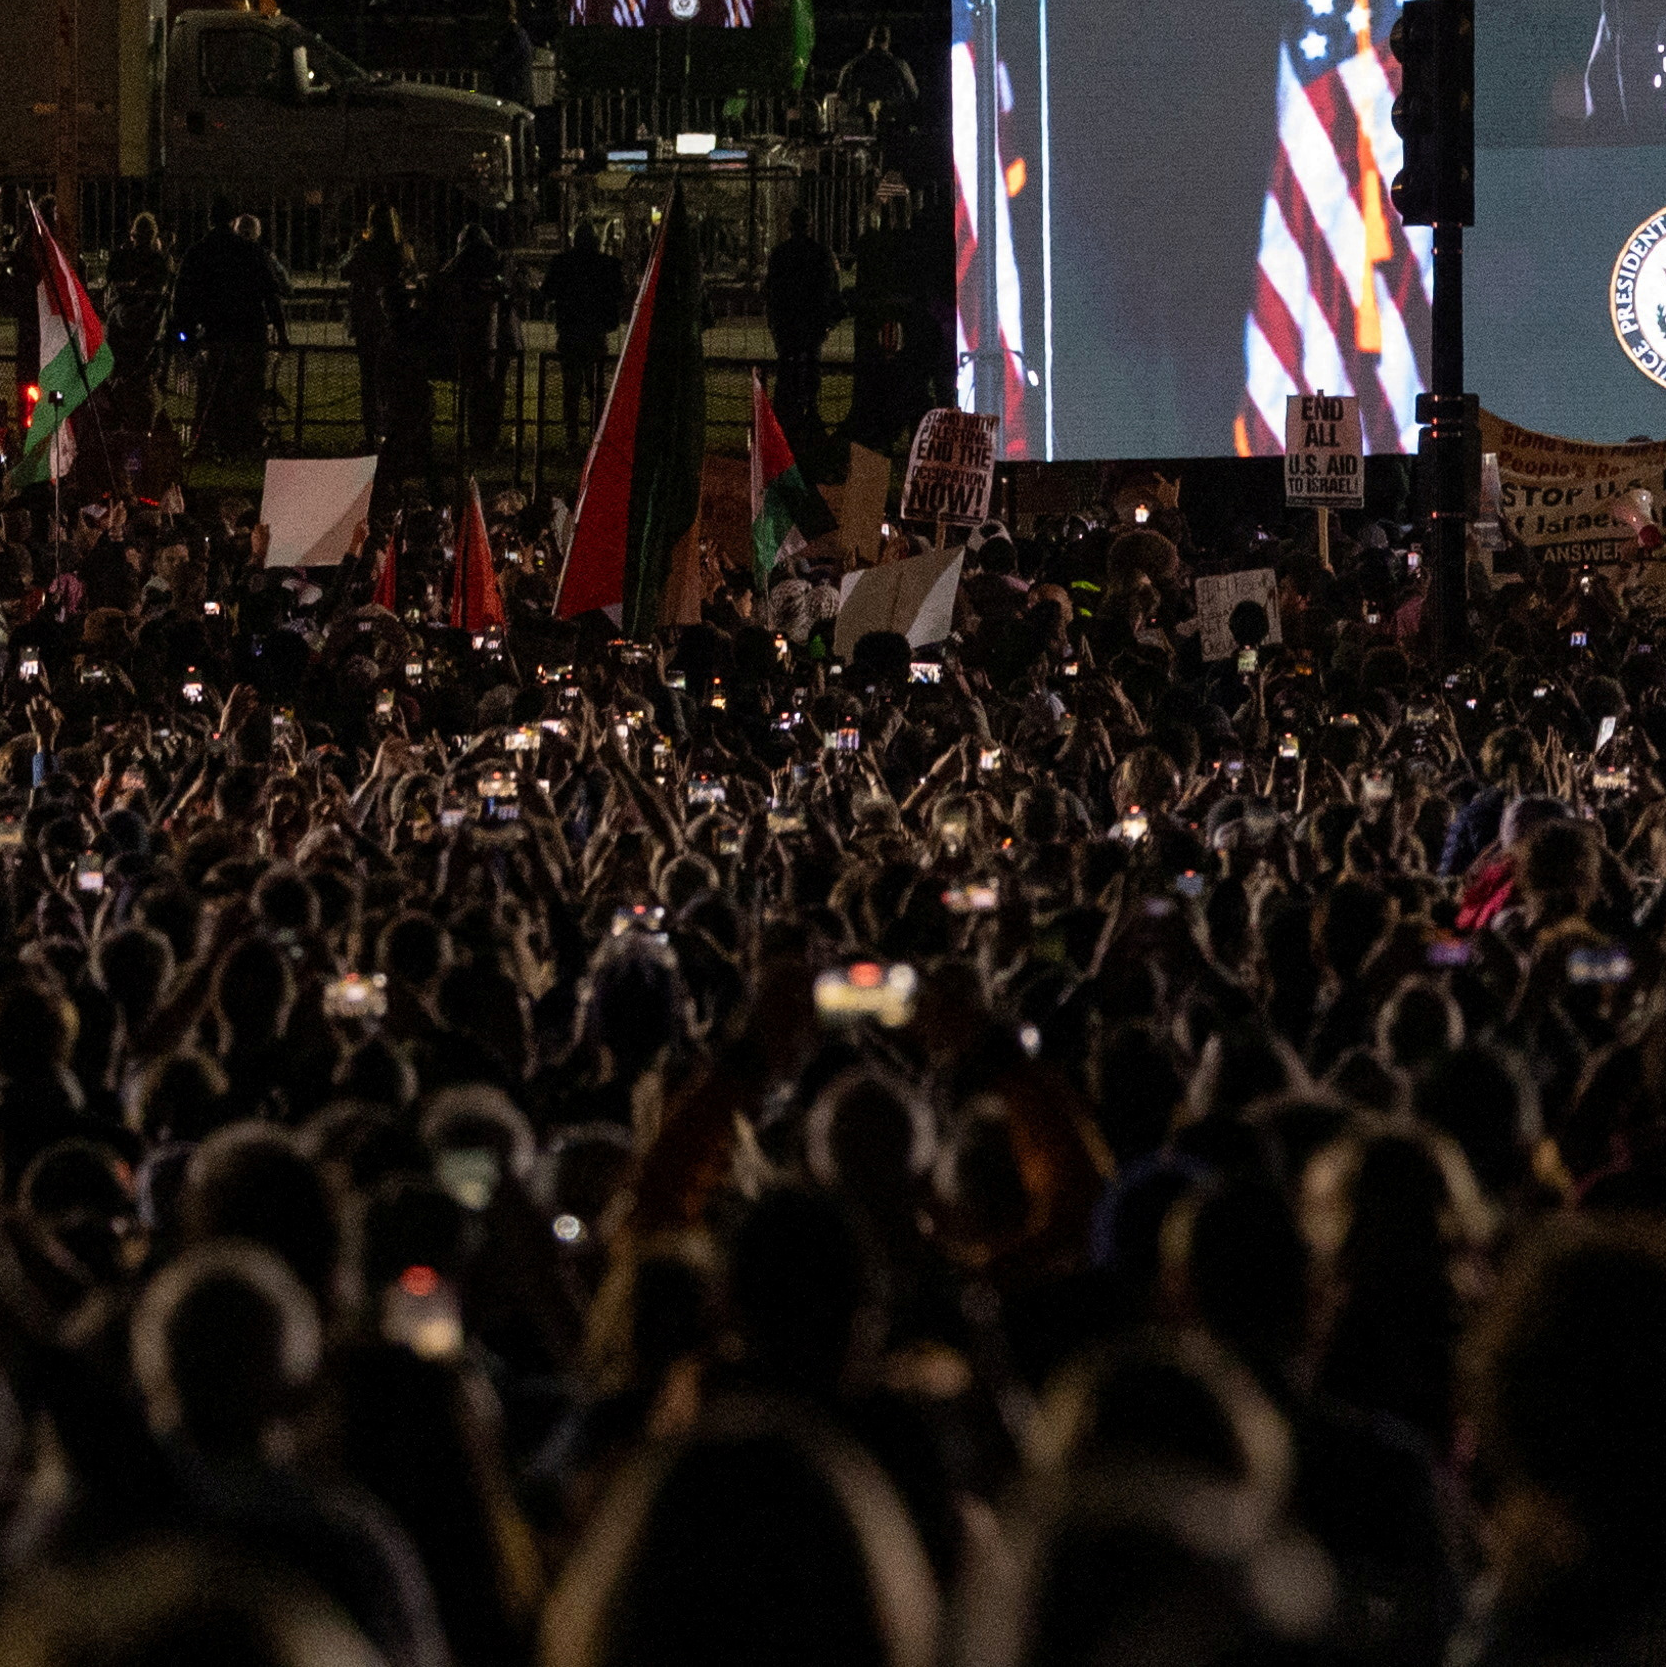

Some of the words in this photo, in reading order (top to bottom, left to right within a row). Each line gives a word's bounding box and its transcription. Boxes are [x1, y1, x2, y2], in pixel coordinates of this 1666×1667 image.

[1301, 397, 1344, 421] END
[1304, 423, 1340, 447] ALL
[916, 439, 954, 461] END
[960, 443, 992, 471] THE
[1289, 454, 1321, 474] U.S.
[1326, 454, 1358, 475] AID
[1288, 478, 1303, 492] TO
[1307, 477, 1359, 494] ISRAEL!
[1501, 482, 1583, 509] STOP
[908, 480, 983, 517] NOW!
